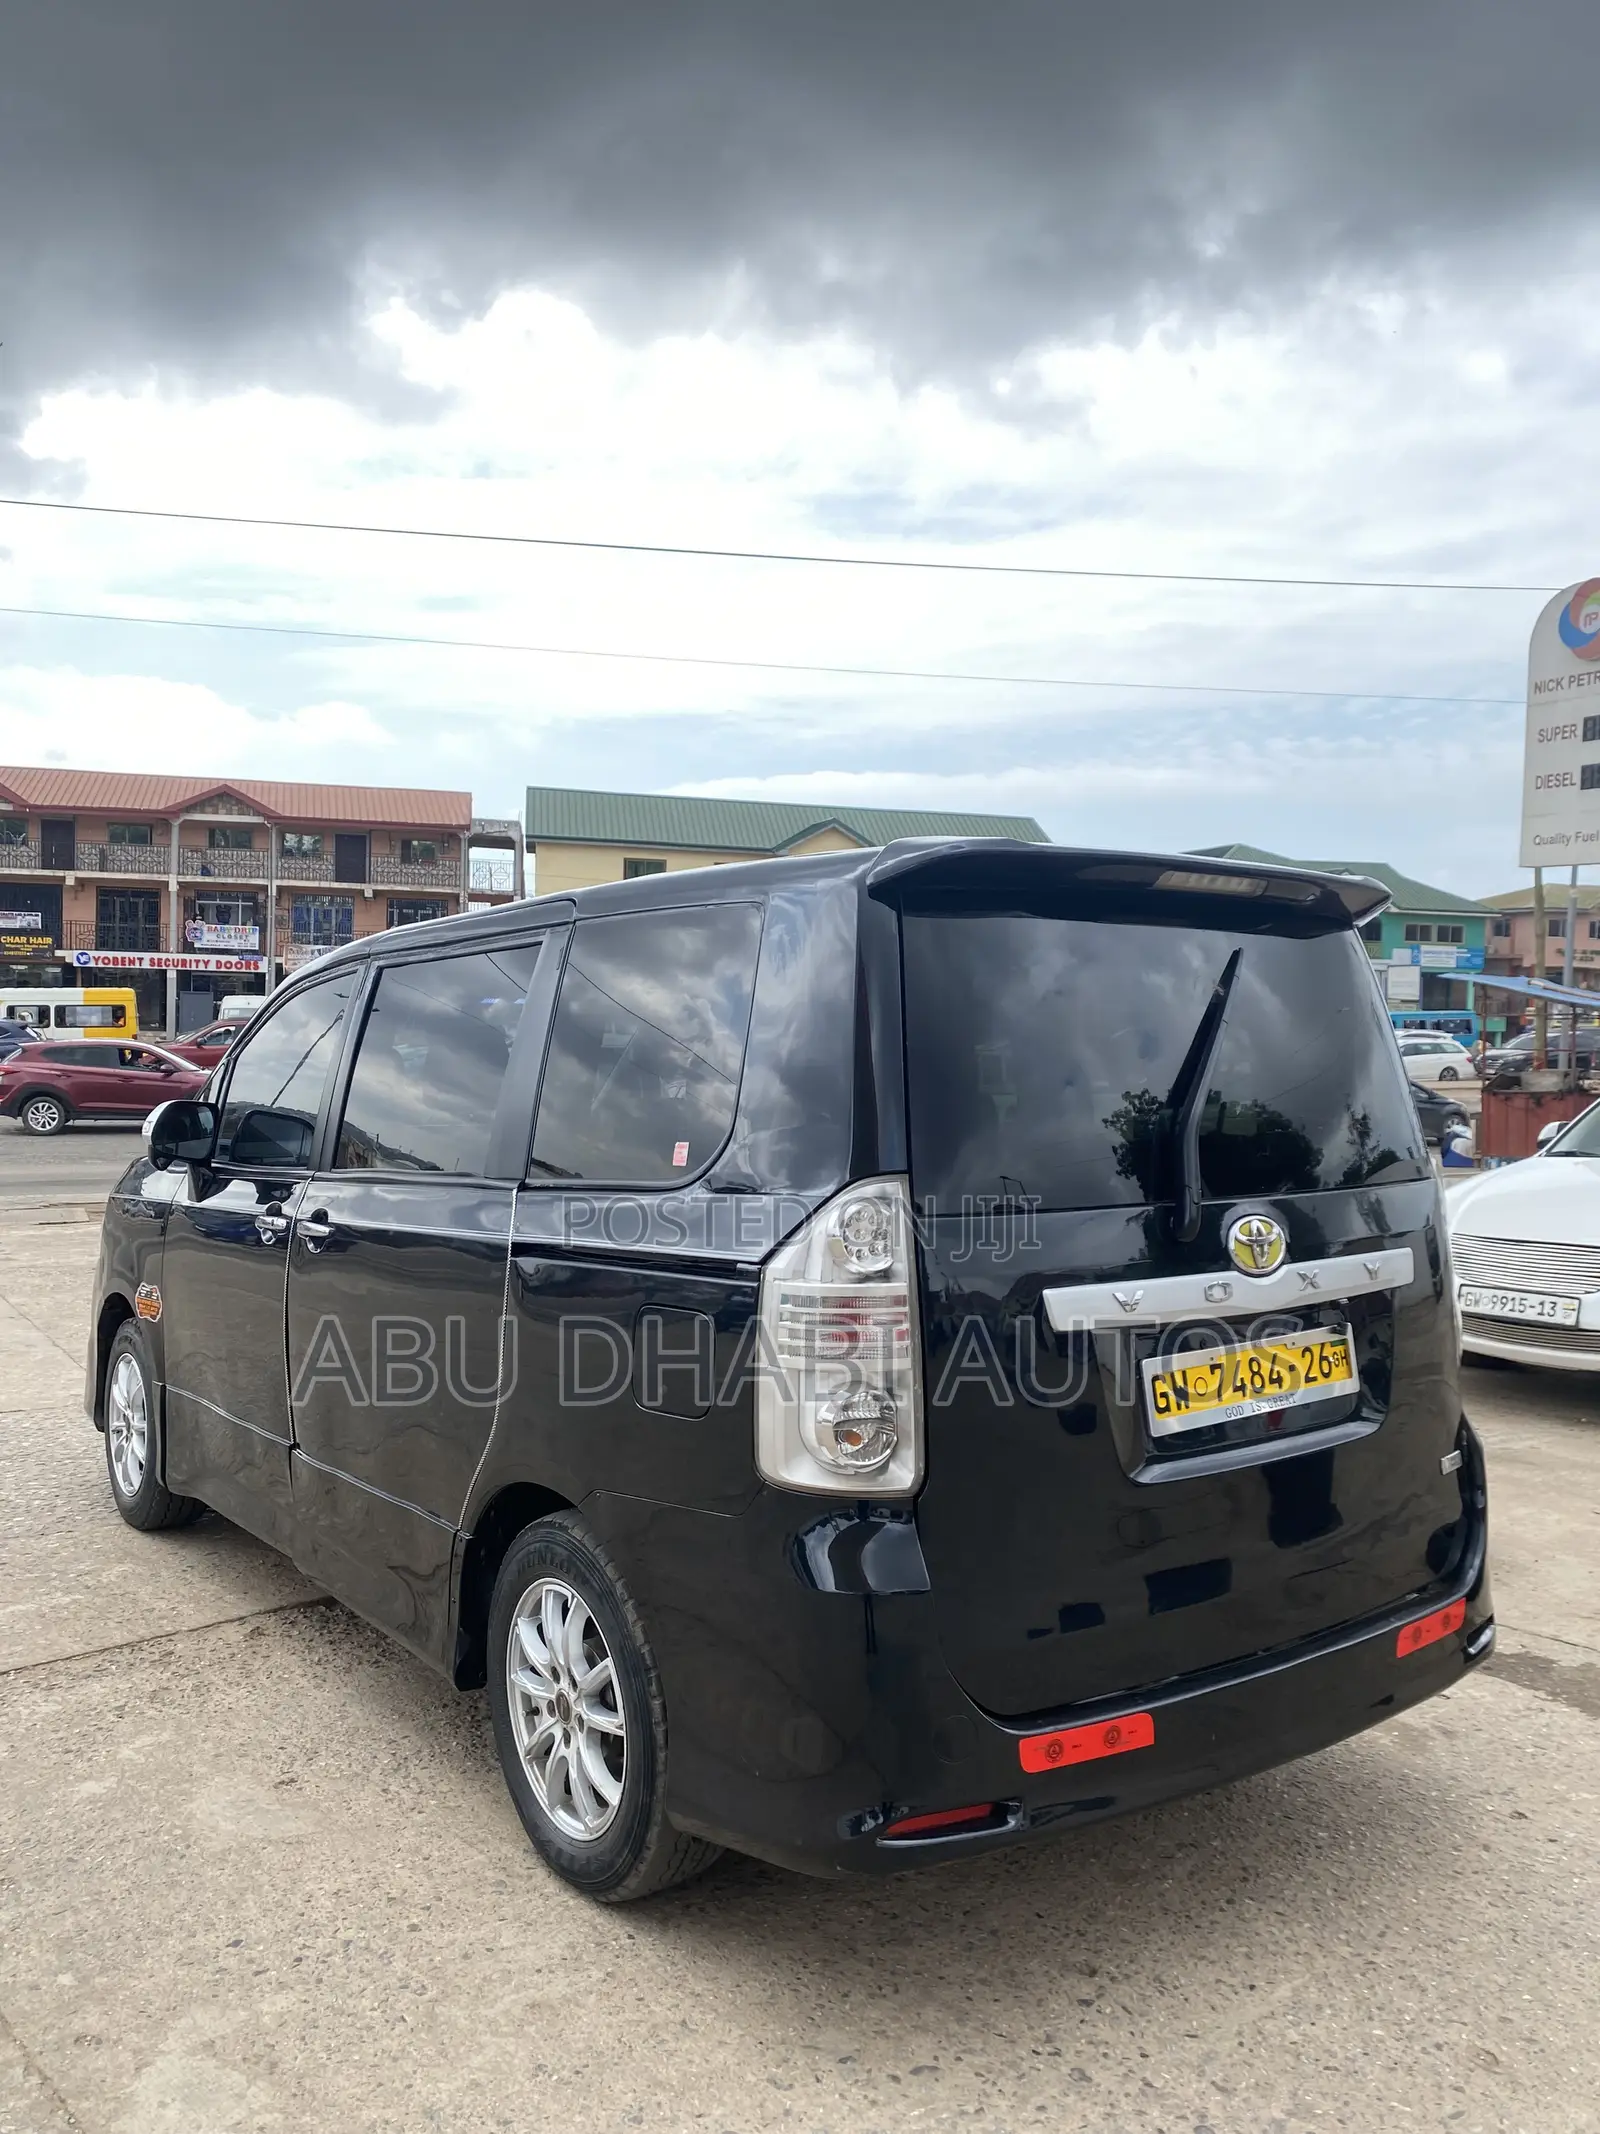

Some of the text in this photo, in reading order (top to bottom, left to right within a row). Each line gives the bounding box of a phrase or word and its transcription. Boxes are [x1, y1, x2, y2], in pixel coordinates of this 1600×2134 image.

[1534, 675, 1565, 695] NICK
[1538, 723, 1578, 743] SUPER
[1535, 772, 1577, 790] DIESEL
[1533, 829, 1600, 847] Quality Fuel
[1, 935, 53, 945] CHAR HAIR
[207, 925, 258, 936] BABY DRIP
[92, 955, 260, 971] YOBENT SECURITY DOORS
[1111, 1260, 1381, 1313] VOXY
[1491, 1294, 1558, 1318] 9915-13
[1151, 1369, 1190, 1415] GW
[1225, 1393, 1297, 1419] GOD IS GREAT
